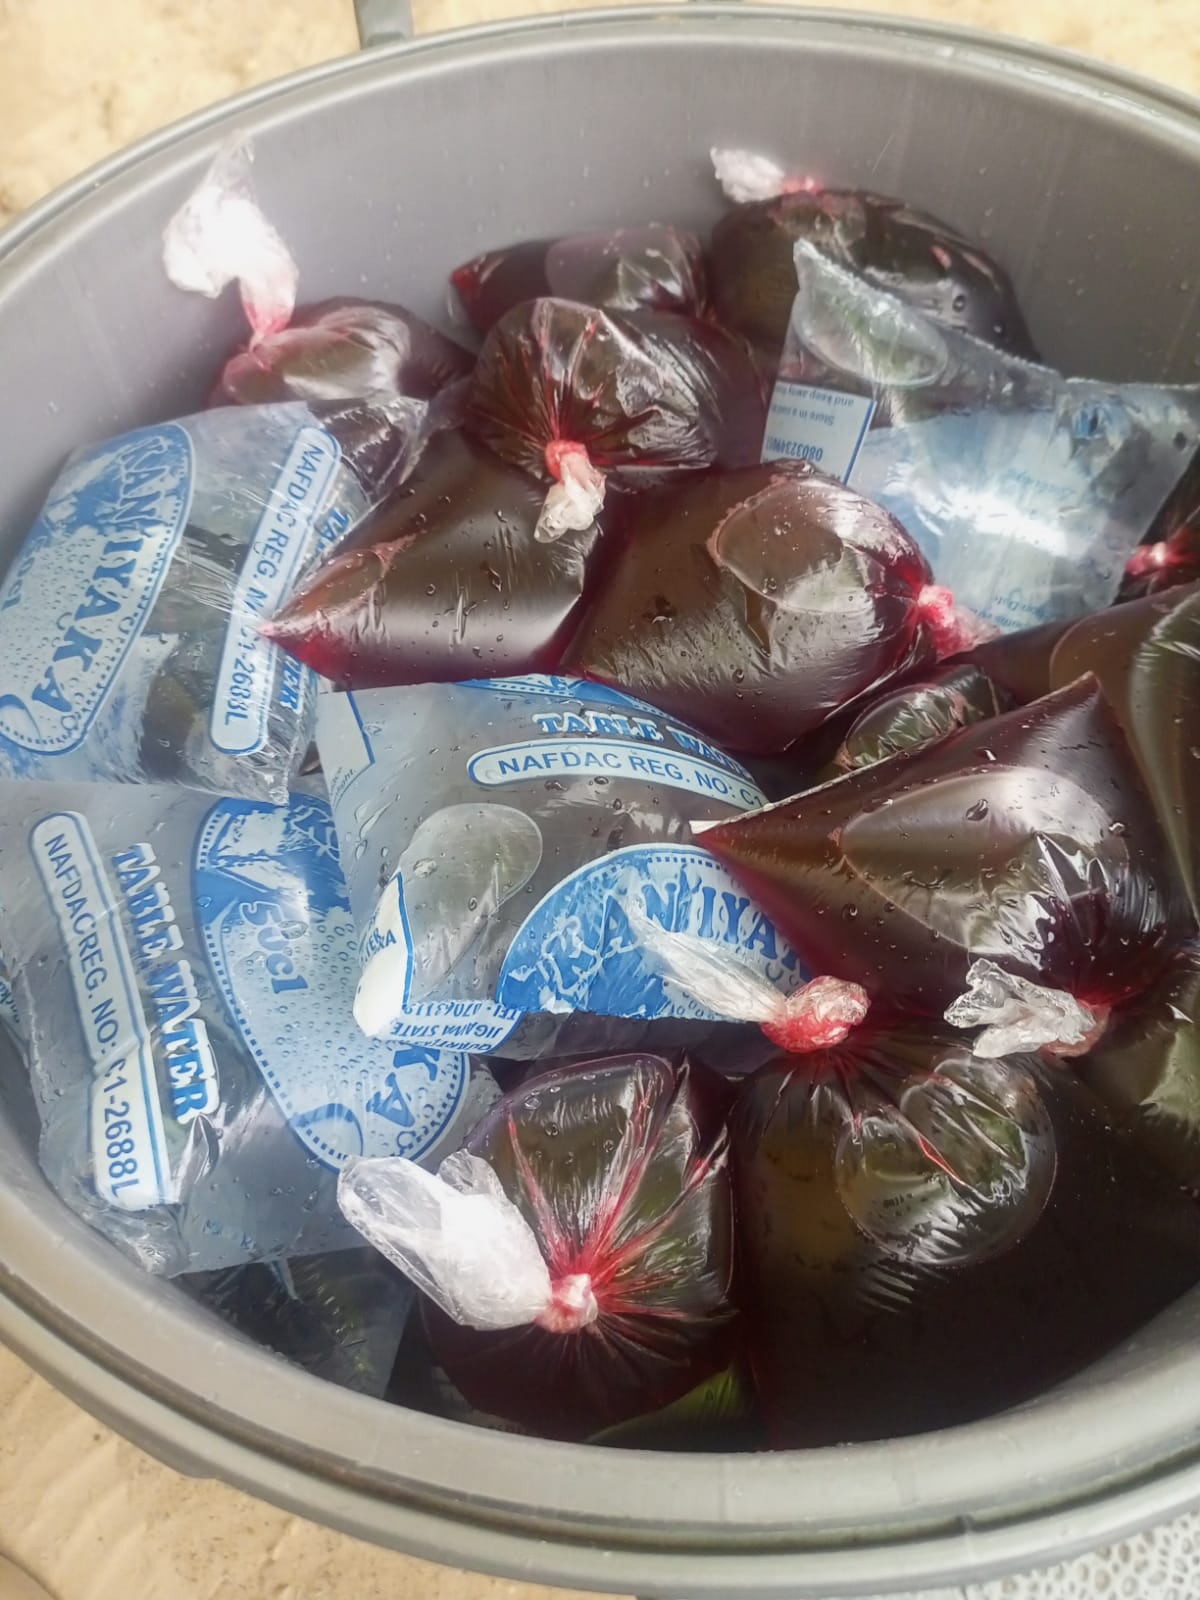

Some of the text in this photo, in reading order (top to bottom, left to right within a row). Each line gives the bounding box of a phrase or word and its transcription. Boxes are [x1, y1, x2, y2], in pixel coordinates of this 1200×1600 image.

[276, 443, 324, 528] NAFDAC
[32, 433, 170, 713] KANIYAKA
[253, 528, 289, 580] REG.
[533, 710, 665, 743] TABLE
[498, 751, 622, 776] NAFDAC
[628, 755, 691, 784] REG.
[695, 772, 737, 798] NO:
[44, 833, 141, 1198] NAFDAC REG. NO: C1-2688L
[111, 842, 220, 1126] TABLE WATER
